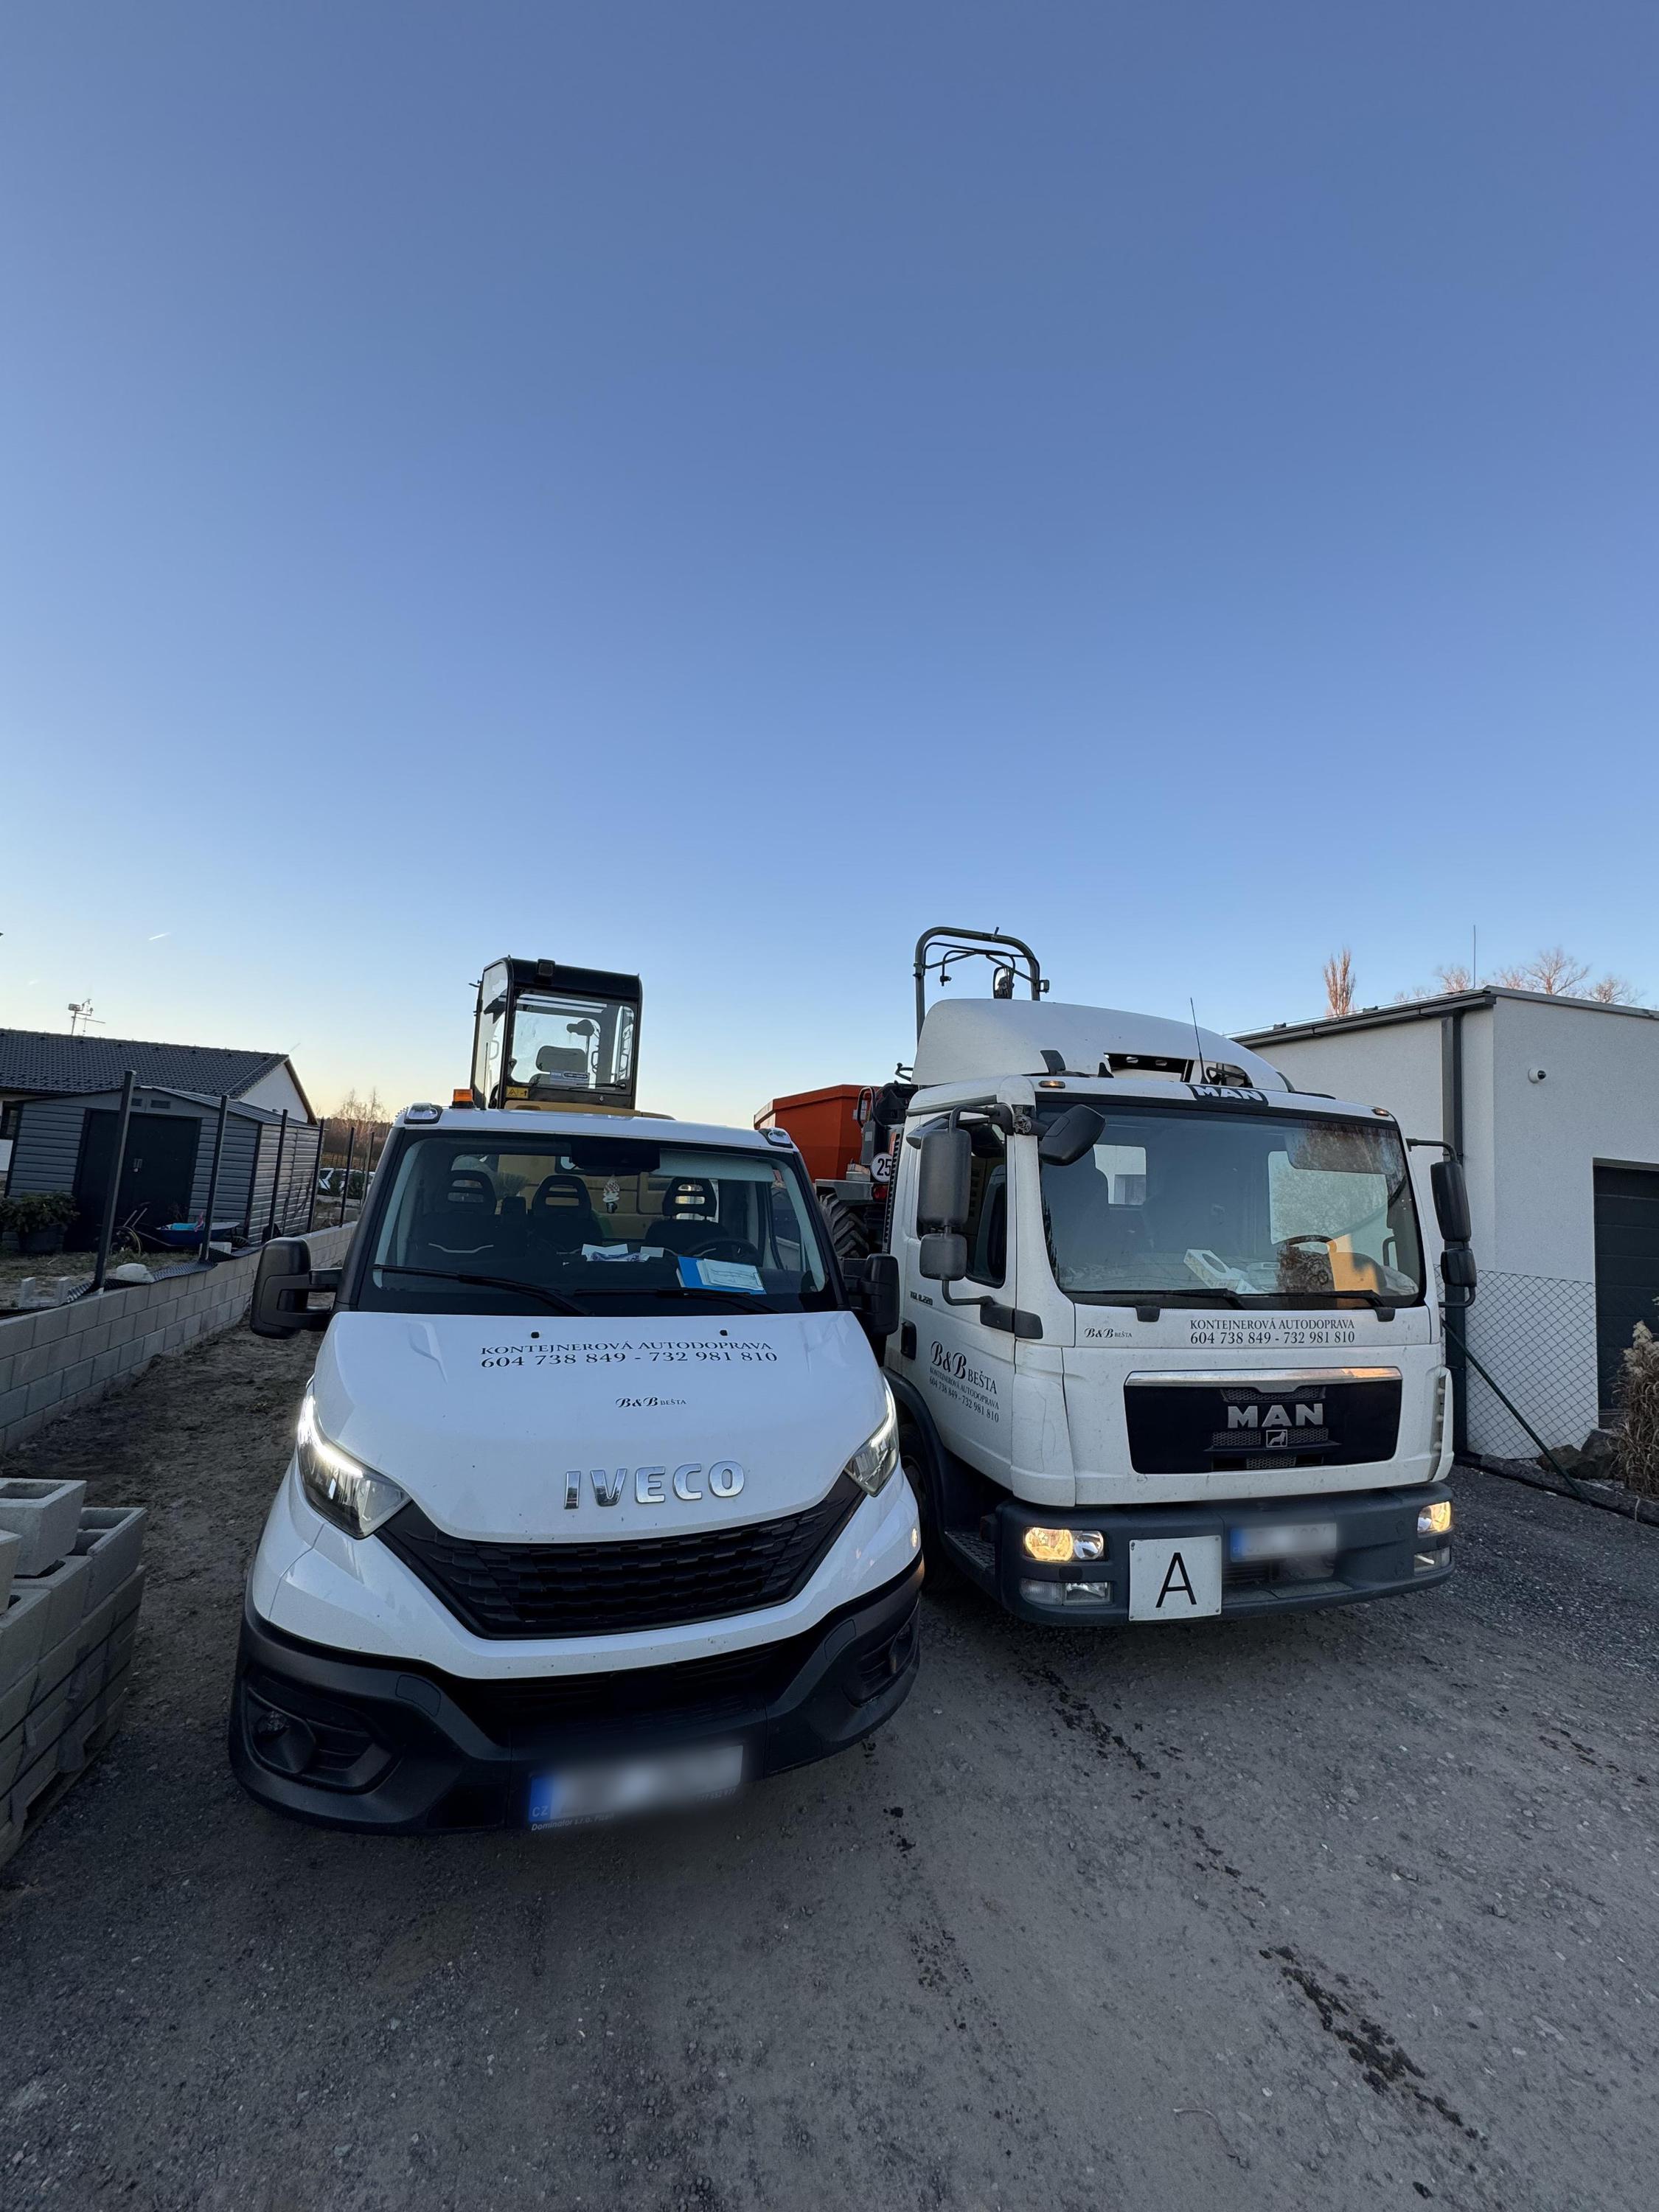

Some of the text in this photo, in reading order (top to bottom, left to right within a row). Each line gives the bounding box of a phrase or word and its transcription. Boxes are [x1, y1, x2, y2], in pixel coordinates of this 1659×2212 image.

[1192, 1085, 1264, 1102] MAN
[876, 1158, 892, 1177] 25
[1084, 1327, 1133, 1338] B&B BEŠTA
[1190, 1318, 1355, 1331] KONTEJNEROVÁ AUTODOPRAVA
[1190, 1332, 1215, 1344] 604
[1220, 1332, 1244, 1344] 738
[1248, 1332, 1271, 1344] 849
[1284, 1332, 1305, 1343] 732
[1309, 1331, 1329, 1343] 981
[1334, 1331, 1355, 1343] 810
[481, 1340, 773, 1355] KONTEJNEROVÁ AUTODOPRAVA
[481, 1356, 525, 1368] 604
[535, 1354, 577, 1366] 738
[586, 1352, 626, 1364] 849
[649, 1352, 689, 1362] 732
[695, 1352, 732, 1362] 981
[740, 1352, 778, 1362] 810
[931, 1340, 998, 1395] B&B BEŠTA
[615, 1397, 687, 1408] B&B BEŠTA
[929, 1376, 939, 1388] 604
[939, 1381, 947, 1394] 738
[948, 1387, 958, 1400] 849
[962, 1395, 973, 1409] 732
[973, 1402, 984, 1416] 981
[987, 1408, 1000, 1423] 810
[960, 1385, 1000, 1411] AUTODOPRAVA
[1227, 1402, 1324, 1429] MAN
[564, 1460, 745, 1510] IVECO
[1155, 1551, 1197, 1609] A
[532, 1805, 549, 1818] CZ
[531, 1819, 573, 1831] Dominator
